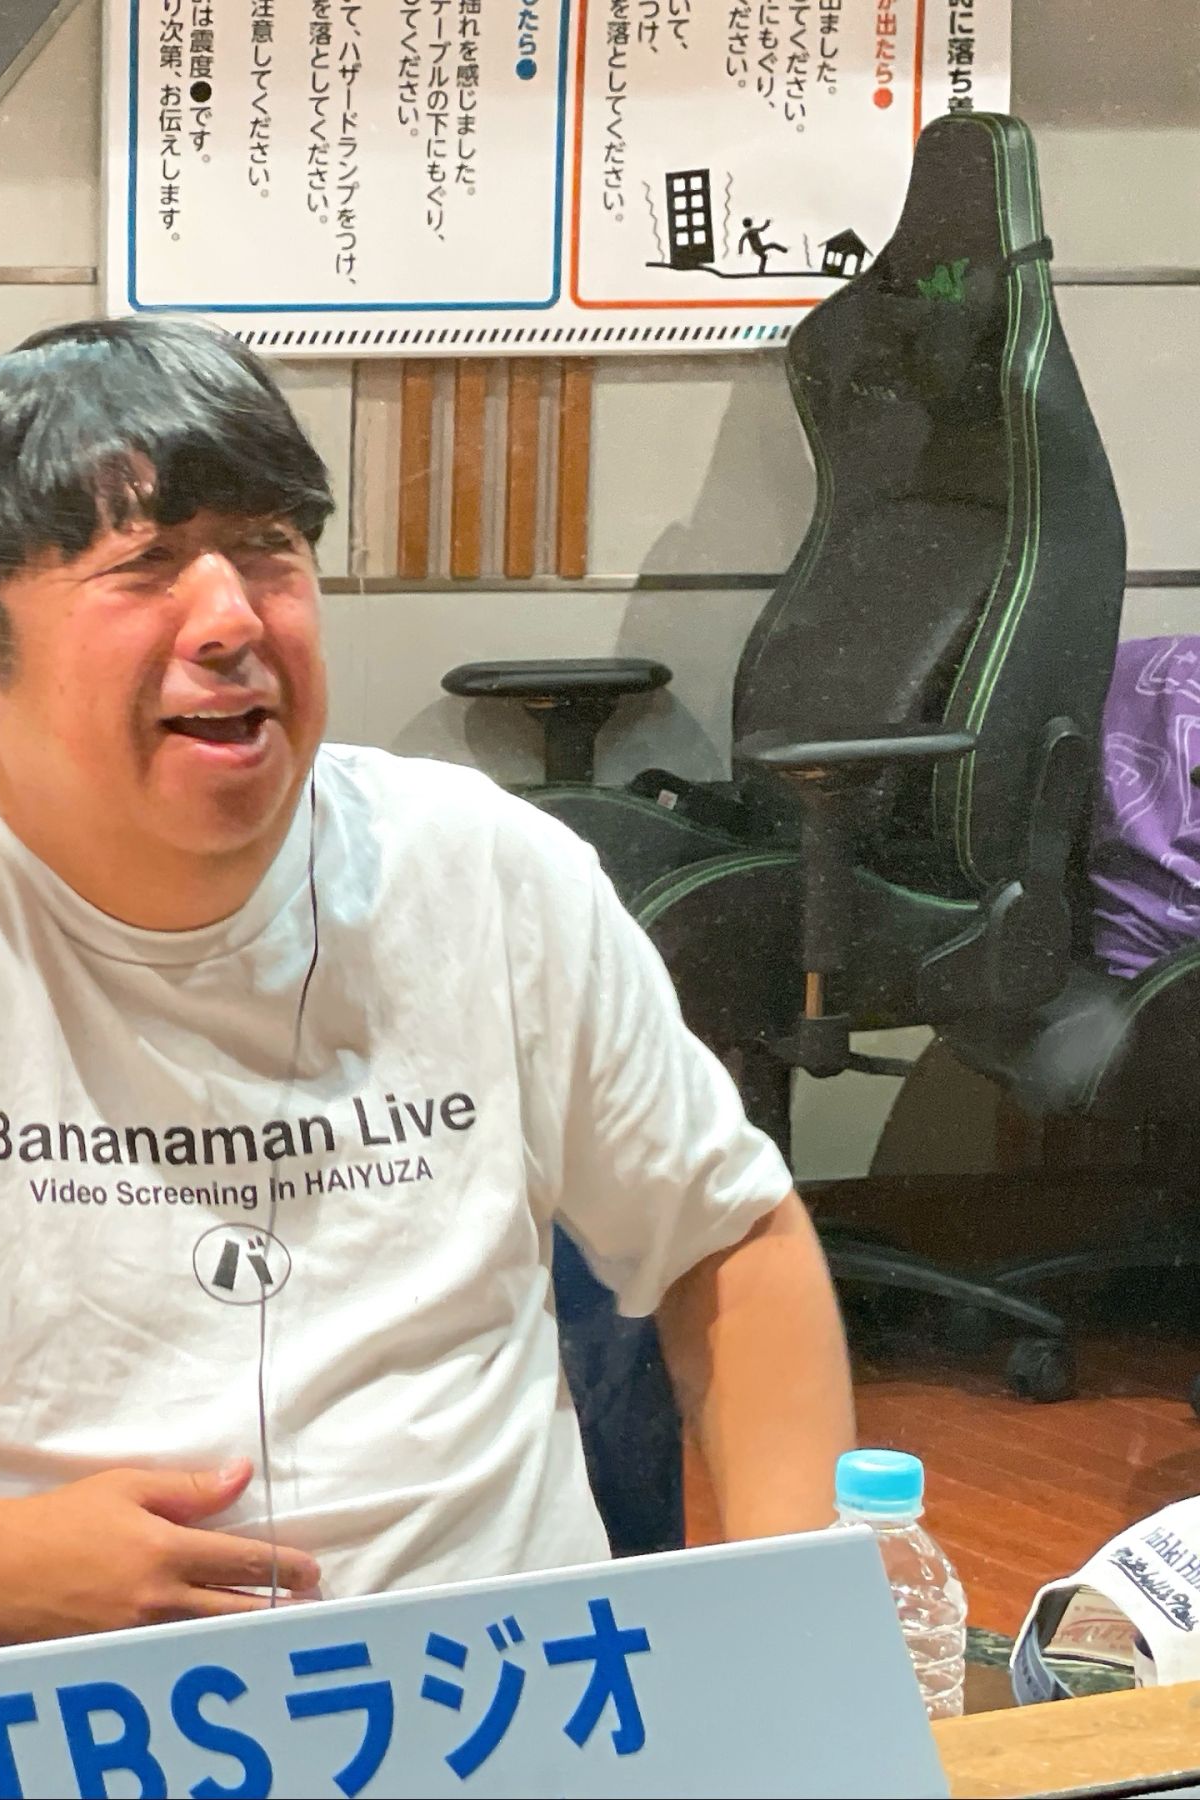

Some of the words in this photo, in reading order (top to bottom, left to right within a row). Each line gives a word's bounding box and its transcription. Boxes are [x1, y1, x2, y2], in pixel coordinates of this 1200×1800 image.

[188, 0, 214, 163] は震度●です。
[249, 0, 274, 198] 注意してください。
[307, 0, 333, 224] を落としてください。
[398, 0, 421, 137] てください。
[603, 0, 631, 222] を落としてください。
[726, 0, 751, 88] ださい。
[757, 0, 780, 108] にもぐり、
[785, 0, 813, 132] てください。
[335, 0, 362, 285] て、ハザードランプをつけ、
[30, 1178, 107, 1206] Video
[116, 1181, 258, 1210] Screening
[269, 1174, 295, 1202] in
[304, 1156, 433, 1196] HAIYUZA
[353, 1092, 477, 1147] Live
